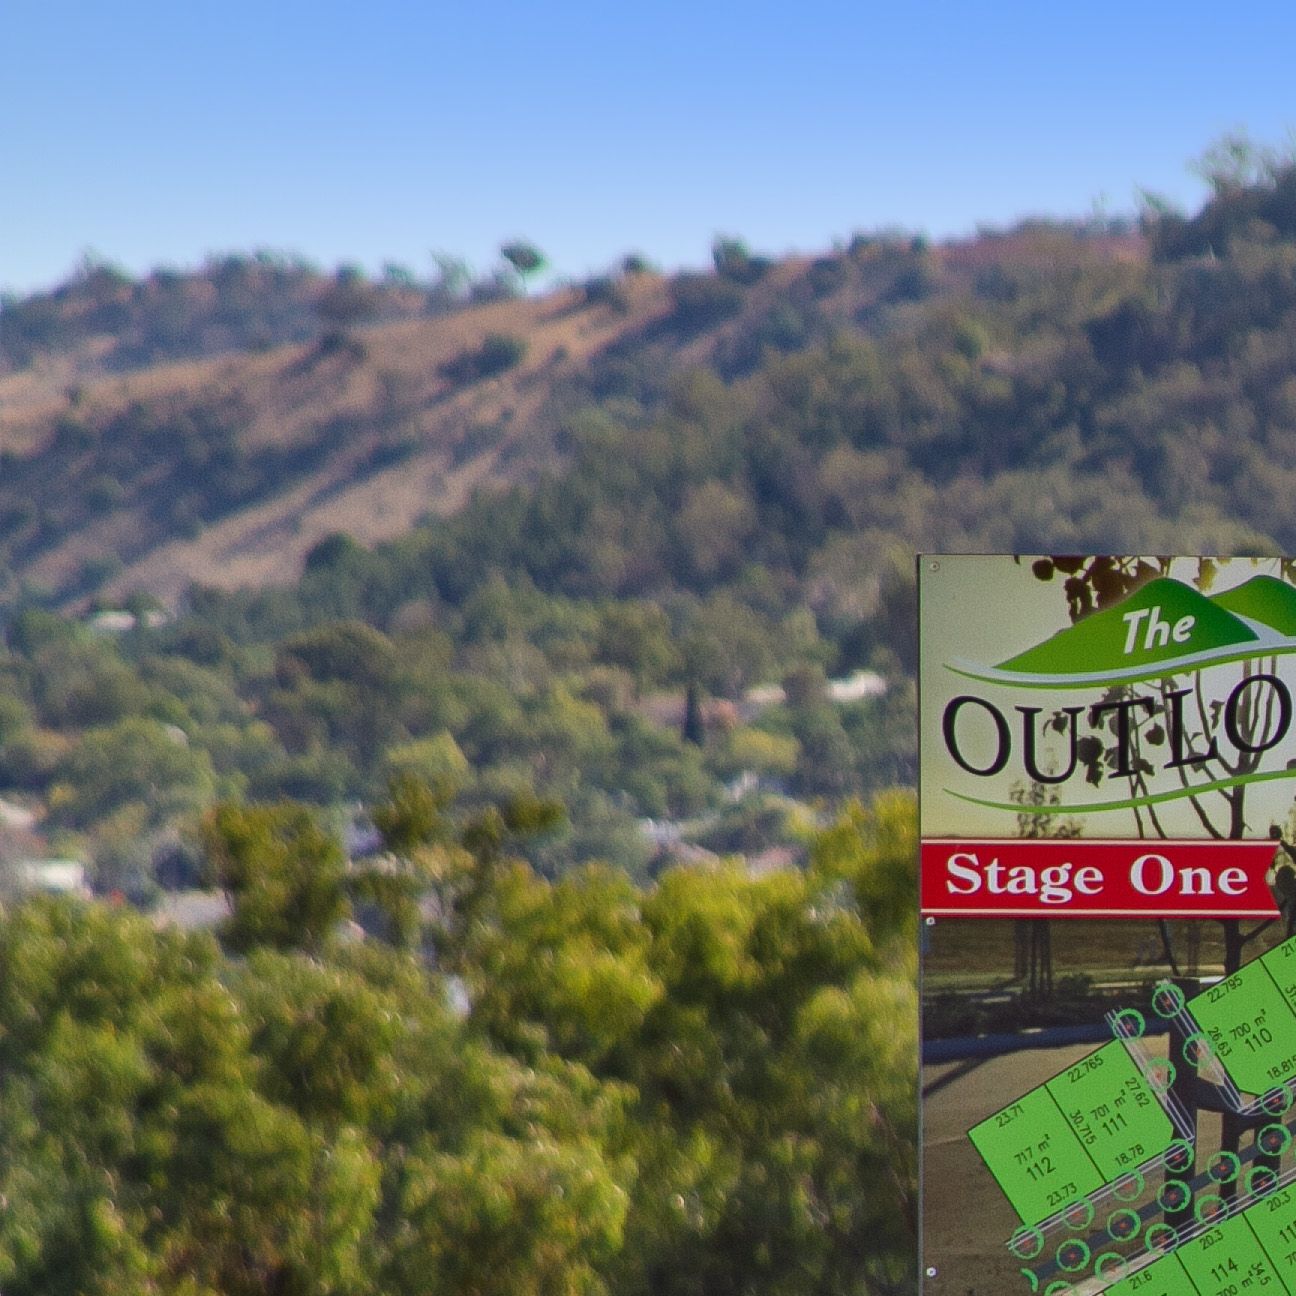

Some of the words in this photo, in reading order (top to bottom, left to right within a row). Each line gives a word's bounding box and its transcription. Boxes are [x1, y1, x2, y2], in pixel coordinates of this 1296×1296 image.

[1121, 607, 1197, 655] The
[945, 853, 1105, 905] Stage
[1129, 854, 1249, 896] One
[1229, 1023, 1251, 1041] 700
[1244, 1028, 1273, 1052] 110
[1067, 1054, 1105, 1084] 22.765
[995, 1104, 1025, 1128] 23.71
[1089, 1103, 1111, 1121] 701
[1102, 1114, 1128, 1136] 111
[1014, 1147, 1034, 1165] 717
[1025, 1156, 1057, 1181] 112
[1046, 1182, 1078, 1207] 23.73
[1211, 1257, 1239, 1282] 114
